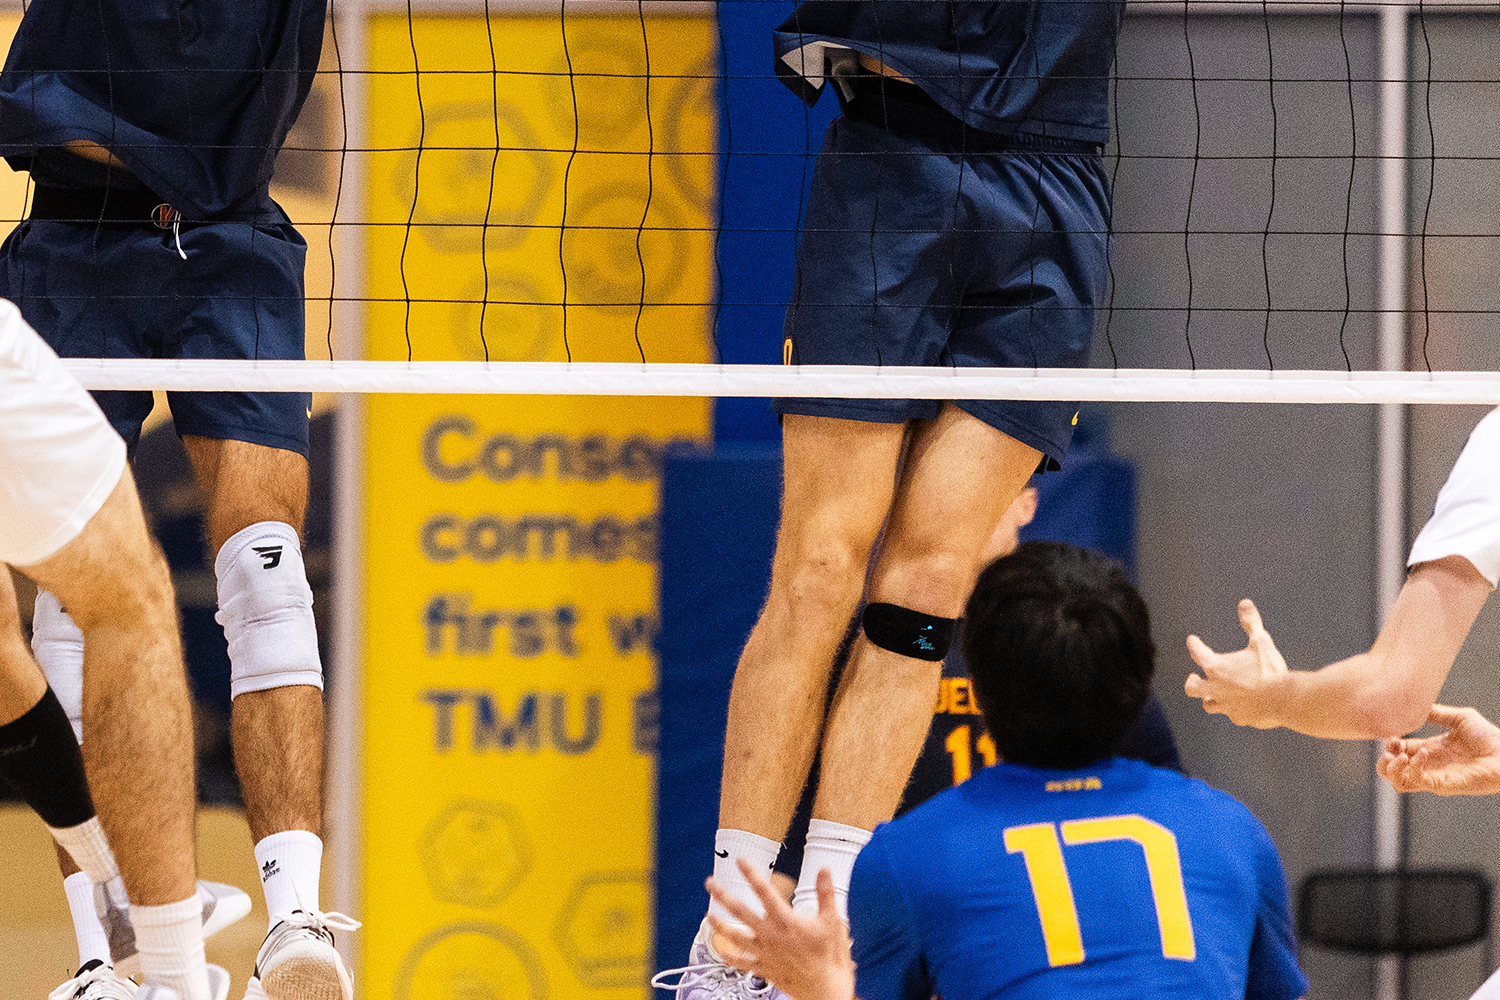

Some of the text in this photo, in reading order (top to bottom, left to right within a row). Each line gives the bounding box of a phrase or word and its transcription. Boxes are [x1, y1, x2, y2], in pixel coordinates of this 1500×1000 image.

[420, 591, 580, 658] first
[418, 688, 603, 757] TMU
[1002, 814, 1197, 968] 17
